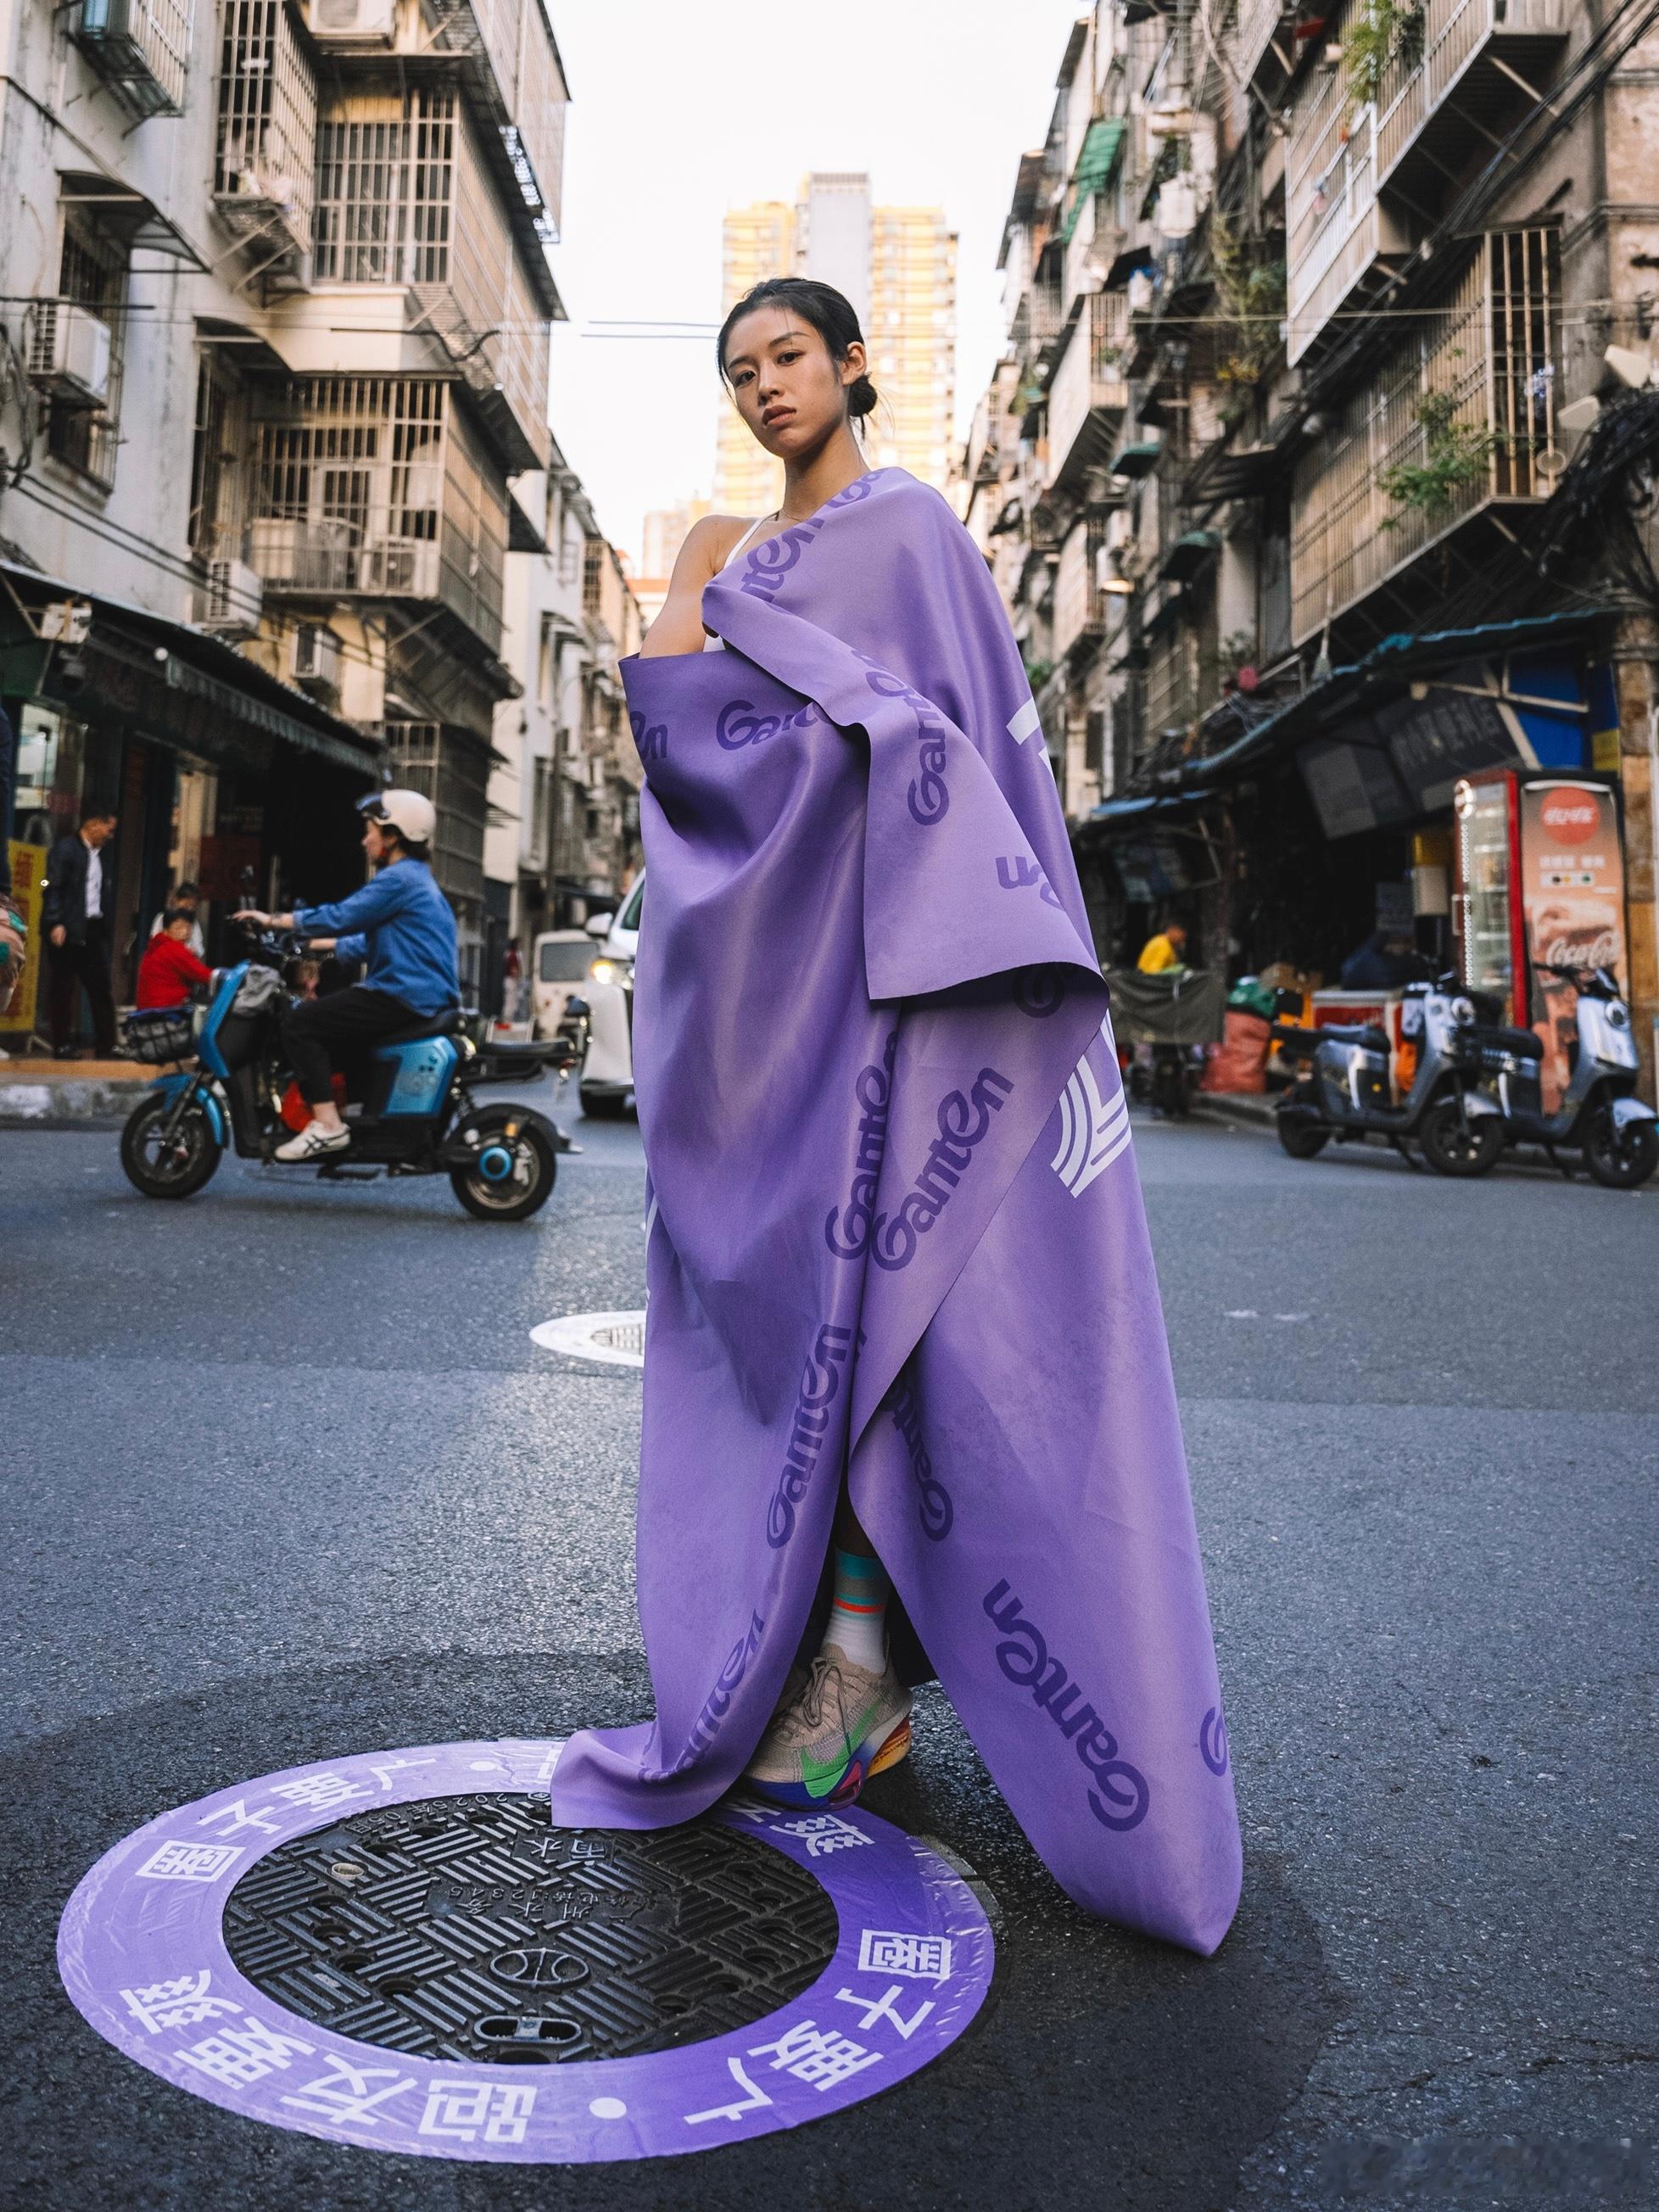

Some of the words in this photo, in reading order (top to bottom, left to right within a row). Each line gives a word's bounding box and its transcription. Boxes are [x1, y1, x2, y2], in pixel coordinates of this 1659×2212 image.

[872, 1068, 1015, 1271] Ganten
[767, 1323, 852, 1549] Ganten
[983, 1578, 1150, 1832] Ganten
[455, 1896, 648, 1924] 广州水务
[522, 1836, 606, 1860] 雨水
